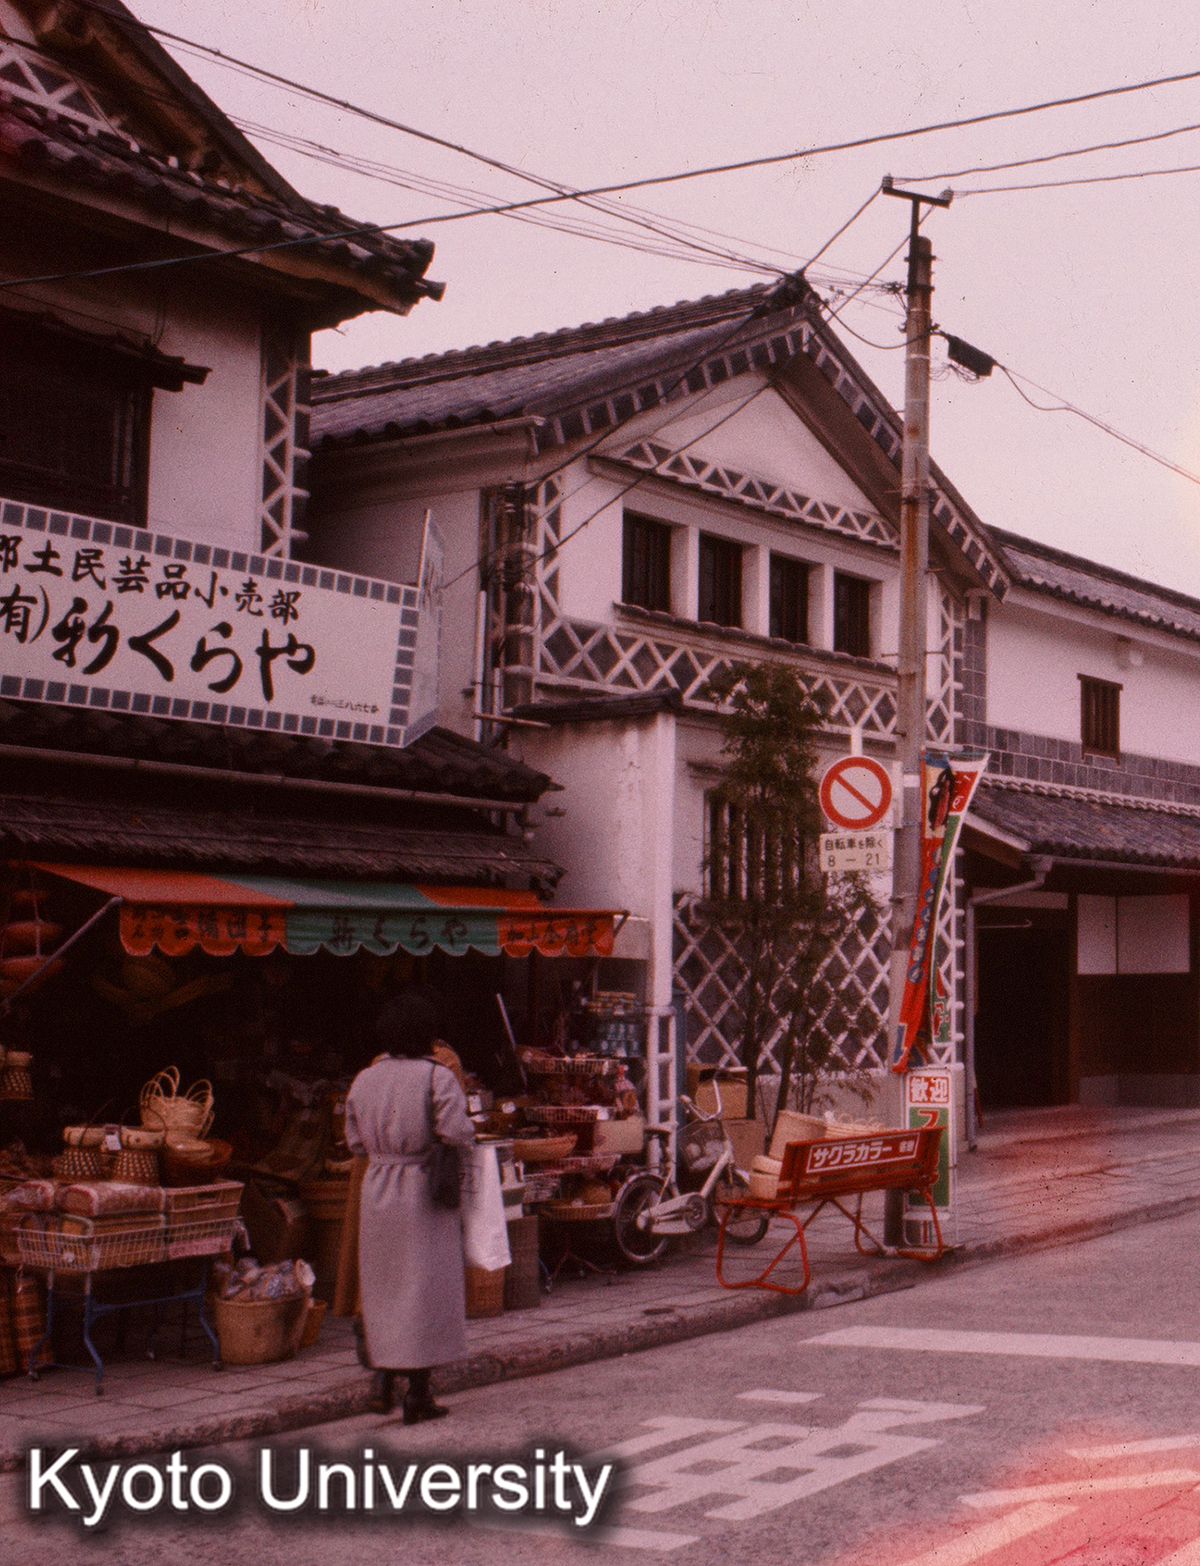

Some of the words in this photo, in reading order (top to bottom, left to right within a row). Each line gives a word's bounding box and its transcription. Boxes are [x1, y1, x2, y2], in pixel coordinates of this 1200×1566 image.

[824, 836, 884, 851] 自転車を除く
[911, 1077, 949, 1103] 歓迎
[813, 1141, 893, 1168] サクラカラー
